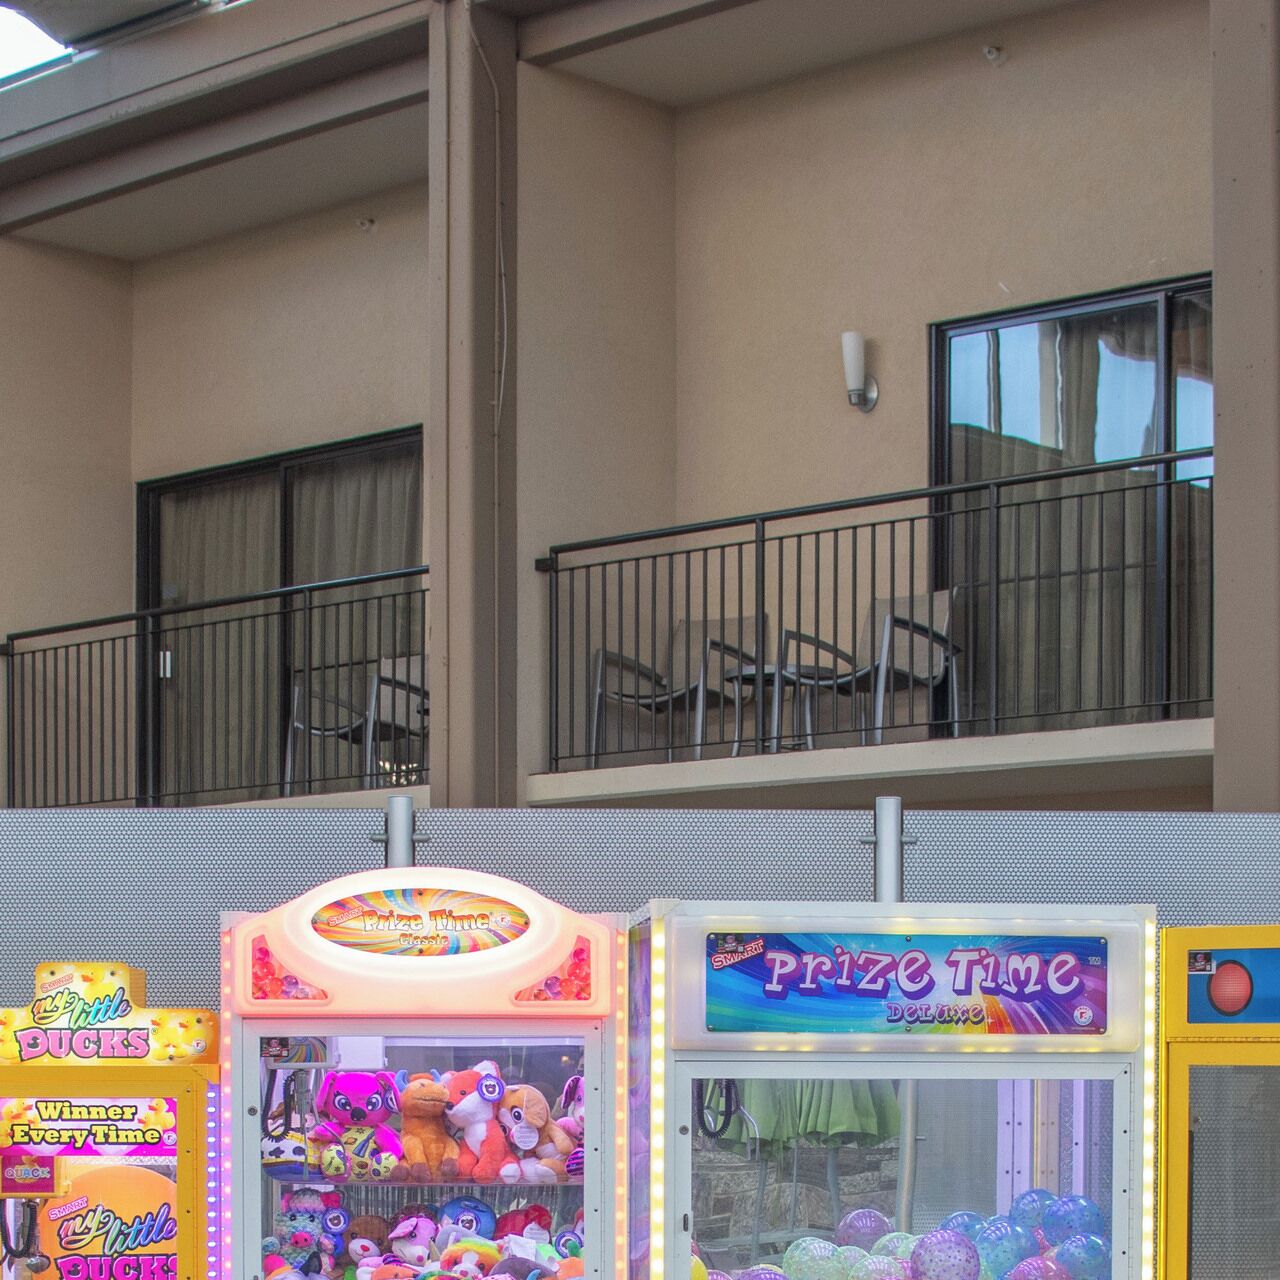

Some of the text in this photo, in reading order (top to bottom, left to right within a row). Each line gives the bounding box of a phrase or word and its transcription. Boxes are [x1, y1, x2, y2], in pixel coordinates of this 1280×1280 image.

[361, 910, 423, 932] Prize
[429, 909, 490, 931] Time
[399, 933, 449, 946] Classic
[711, 938, 765, 970] SMART
[762, 946, 935, 999] Prize
[946, 945, 1085, 1001] Time
[32, 987, 132, 1029] my little
[14, 1027, 150, 1062] DUCKS
[36, 1101, 137, 1121] Winner
[11, 1124, 161, 1149] Every Time
[5, 1167, 51, 1180] QUACK
[48, 1197, 89, 1220] SMART
[57, 1203, 177, 1255] my little
